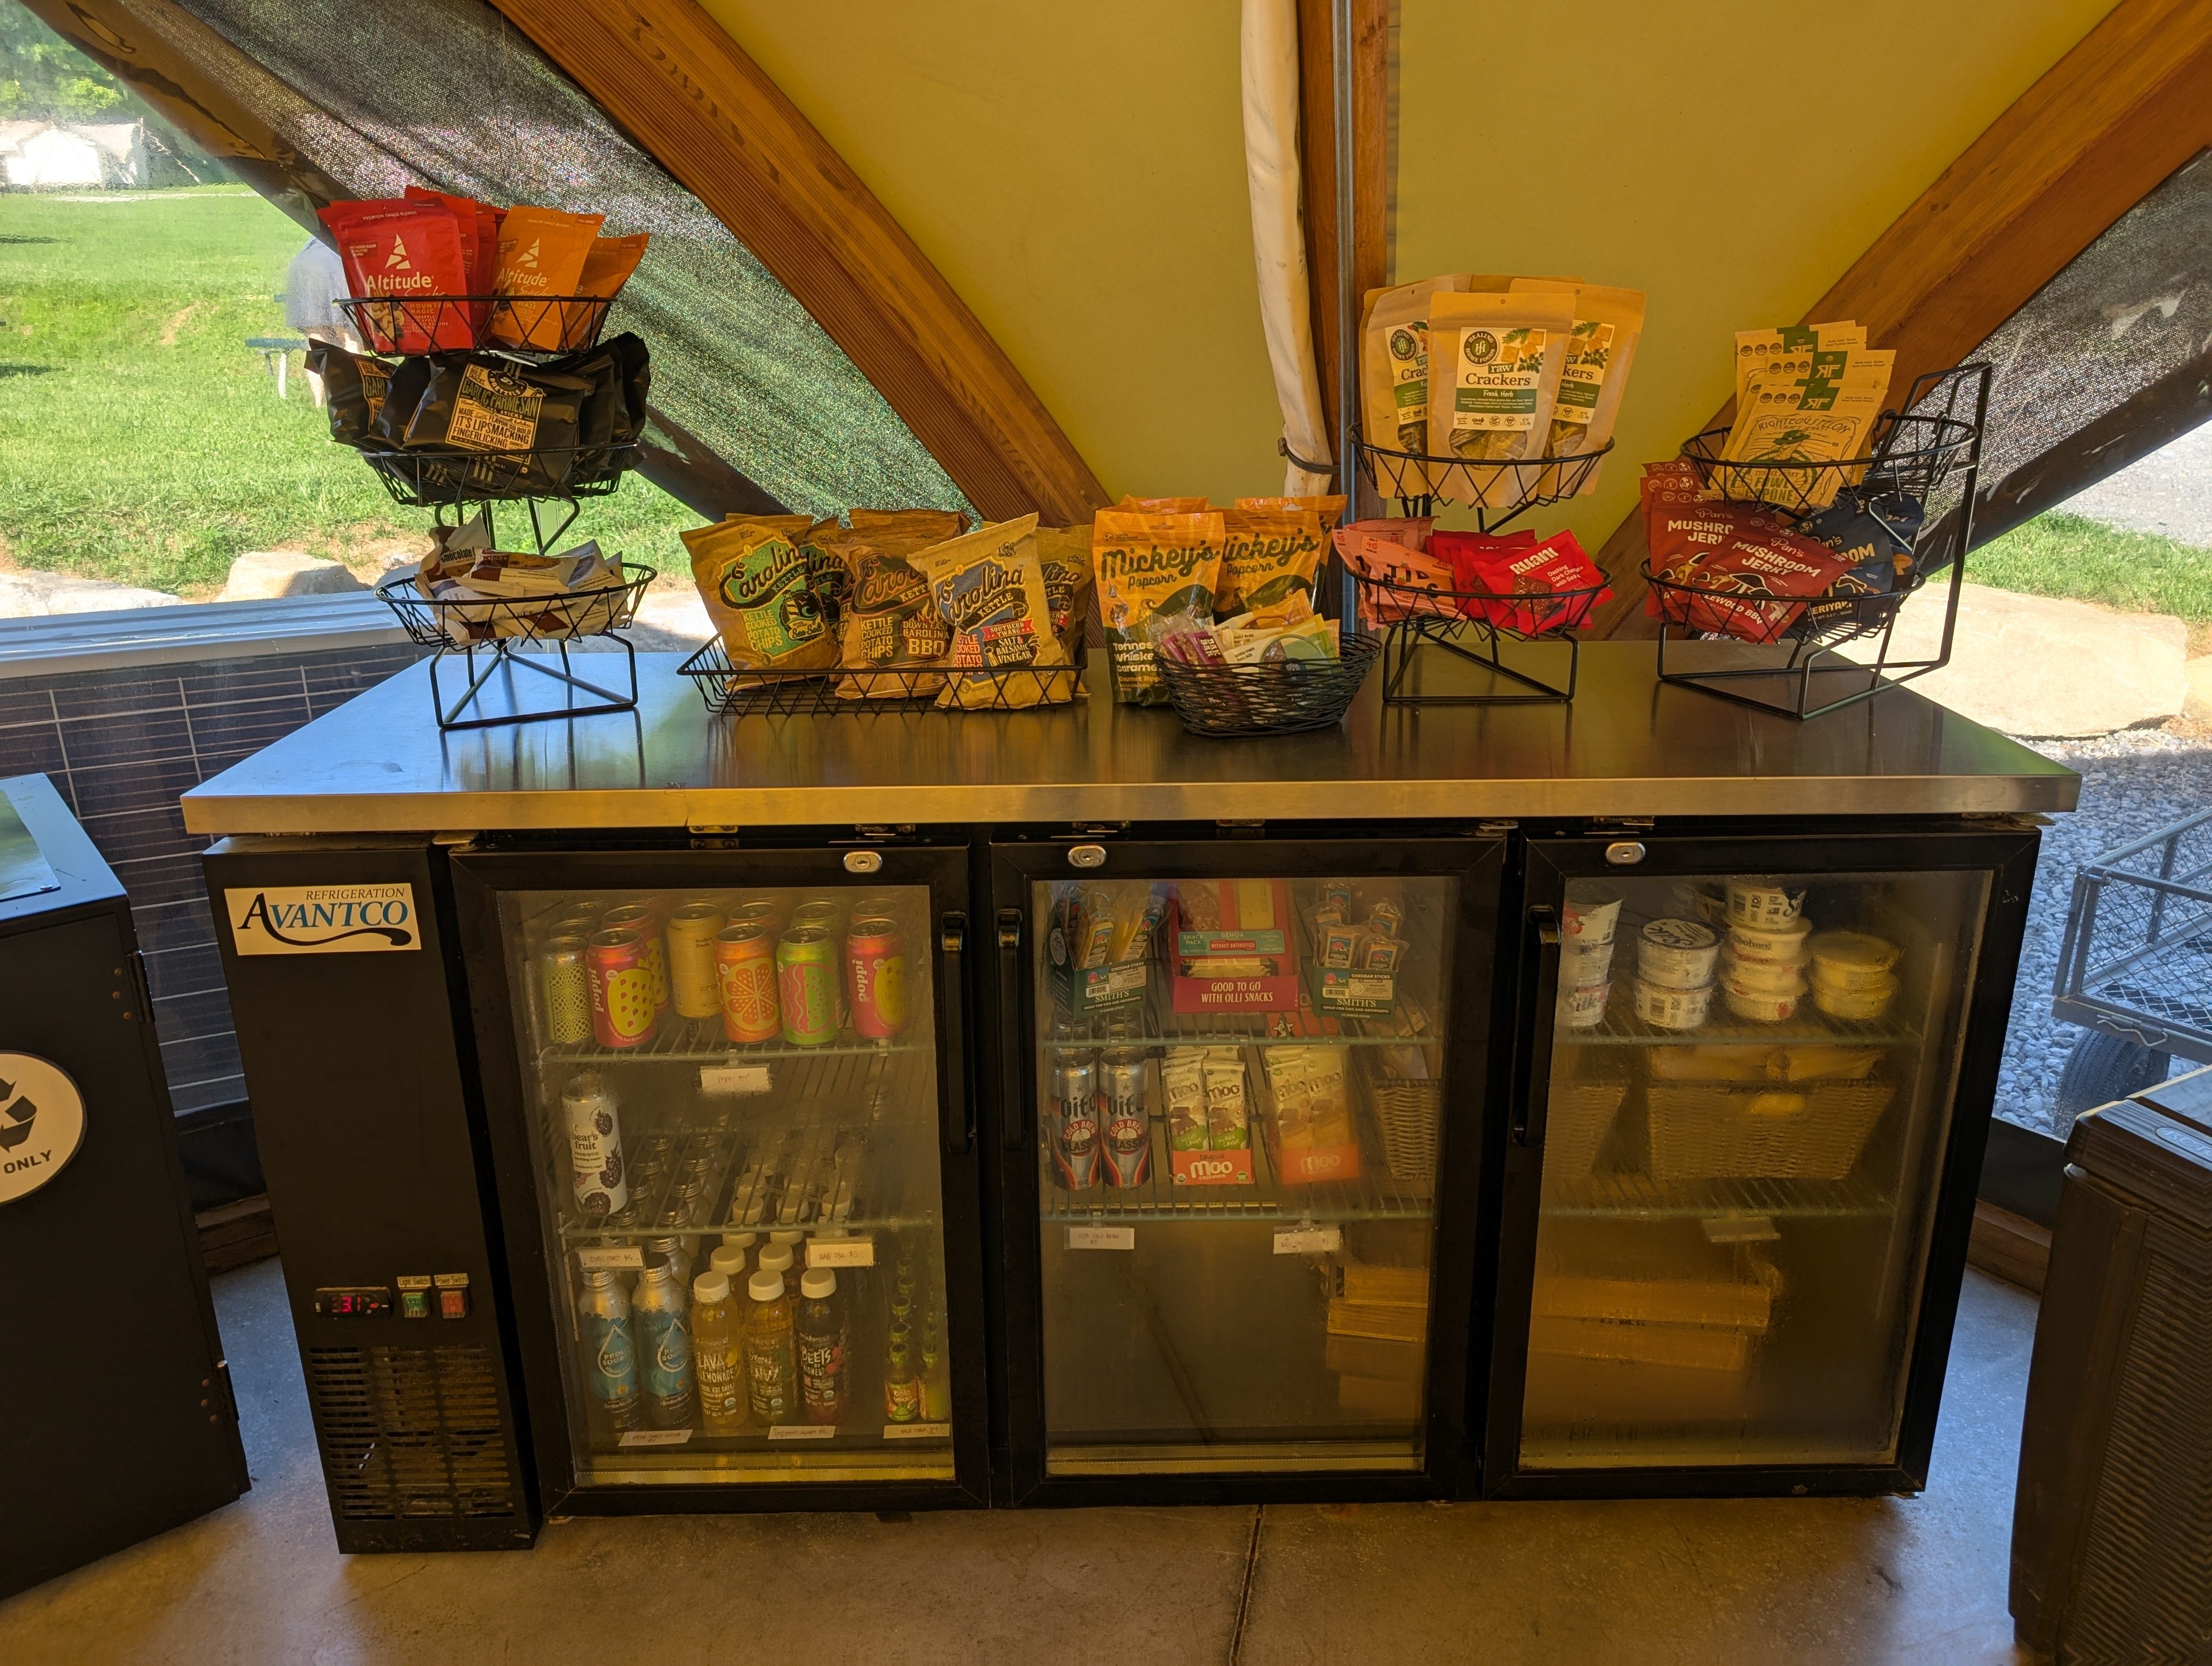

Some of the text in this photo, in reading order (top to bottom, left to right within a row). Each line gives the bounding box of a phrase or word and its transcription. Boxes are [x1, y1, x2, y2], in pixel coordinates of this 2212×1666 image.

[366, 271, 432, 290] Altitude
[497, 267, 548, 286] Altitude
[1392, 330, 1410, 343] HEALING
[1468, 332, 1494, 343] HEALING
[1392, 348, 1405, 360] HOME
[1465, 347, 1495, 363] HOME FOODS
[1491, 364, 1512, 374] raw
[1562, 364, 1594, 380] kers
[489, 378, 520, 396] PRETZELS
[1465, 373, 1531, 386] Crackers
[462, 379, 491, 405] GARLIC
[491, 394, 538, 418] PARMESAN
[458, 407, 474, 418] MADE
[488, 414, 508, 427] FLAVOR
[517, 426, 531, 435] BOLD
[500, 410, 523, 419] STICKS
[455, 415, 530, 444] IT'S LIPSMACKING
[1758, 415, 1851, 434] RIGHTEOUS FELON
[452, 426, 508, 448] FINGERLICKING
[1695, 508, 1733, 518] Pan's
[1668, 520, 1734, 535] MUSHRO
[1223, 528, 1319, 567] ickey's
[1367, 541, 1378, 550] 4G
[1771, 537, 1804, 558] Pan's
[441, 547, 473, 563] Chocolate
[1101, 540, 1220, 582] Mickey's
[1731, 541, 1822, 578] MUSHROOM
[1227, 562, 1274, 578] Popcorn
[1547, 565, 1568, 577] Dashing
[1741, 557, 1793, 576] JERKY
[772, 565, 805, 593] KETTLE
[1128, 573, 1177, 590] Popcorn
[1551, 573, 1564, 582] Dark
[1555, 580, 1566, 588] with
[900, 585, 929, 602] KETT
[938, 564, 1025, 621] Carolina
[978, 592, 1013, 617] KETTLE
[743, 610, 773, 622] KETTLE
[745, 617, 777, 631] COOKED
[860, 617, 893, 629] KETTLE
[792, 623, 824, 639] Sea Salt
[861, 626, 893, 640] COOKED
[903, 621, 949, 630] DOWN EAST
[989, 621, 1025, 633] SOUTHERN
[996, 628, 1020, 637] TWANG
[747, 626, 780, 642] POTATO
[903, 629, 949, 639] CAROLINA
[998, 635, 1024, 648] SALT &
[750, 635, 783, 651] CHIPS
[861, 636, 893, 650] POTATO
[908, 639, 946, 657] BBQ
[996, 643, 1030, 655] BALSAMIC
[1200, 638, 1214, 657] BAR
[861, 646, 893, 660] CHIPS
[953, 654, 982, 665] POTATO
[998, 650, 1033, 664] VINEGAR
[1114, 652, 1154, 663] Whiske
[306, 888, 405, 901] REFRIGERATION
[237, 892, 410, 936] AVANTCO
[599, 951, 623, 959] Strawberry
[852, 958, 869, 1003] poppi
[1211, 981, 1261, 992] GOOD TO GO
[588, 967, 605, 1014] poppi
[1095, 989, 1130, 1003] SMITH'S
[1201, 992, 1274, 1003] WITH OLLI SNACKS
[1336, 998, 1377, 1007] SMITH'S
[1208, 1084, 1241, 1103] moo
[1064, 1120, 1096, 1139] COLD BREW
[1110, 1119, 1142, 1137] COLD BREW
[575, 1141, 597, 1150] fruit
[1062, 1138, 1098, 1154] CLASSIC
[1109, 1139, 1144, 1151] CLASSIC
[4, 1149, 52, 1174] ONLY
[1189, 1161, 1234, 1179] moo
[399, 1276, 429, 1286] Light Switch
[435, 1274, 467, 1285] Power Switch
[698, 1352, 726, 1372] LAVA
[801, 1344, 832, 1364] BEETS
[700, 1367, 735, 1383] LEMONADE
